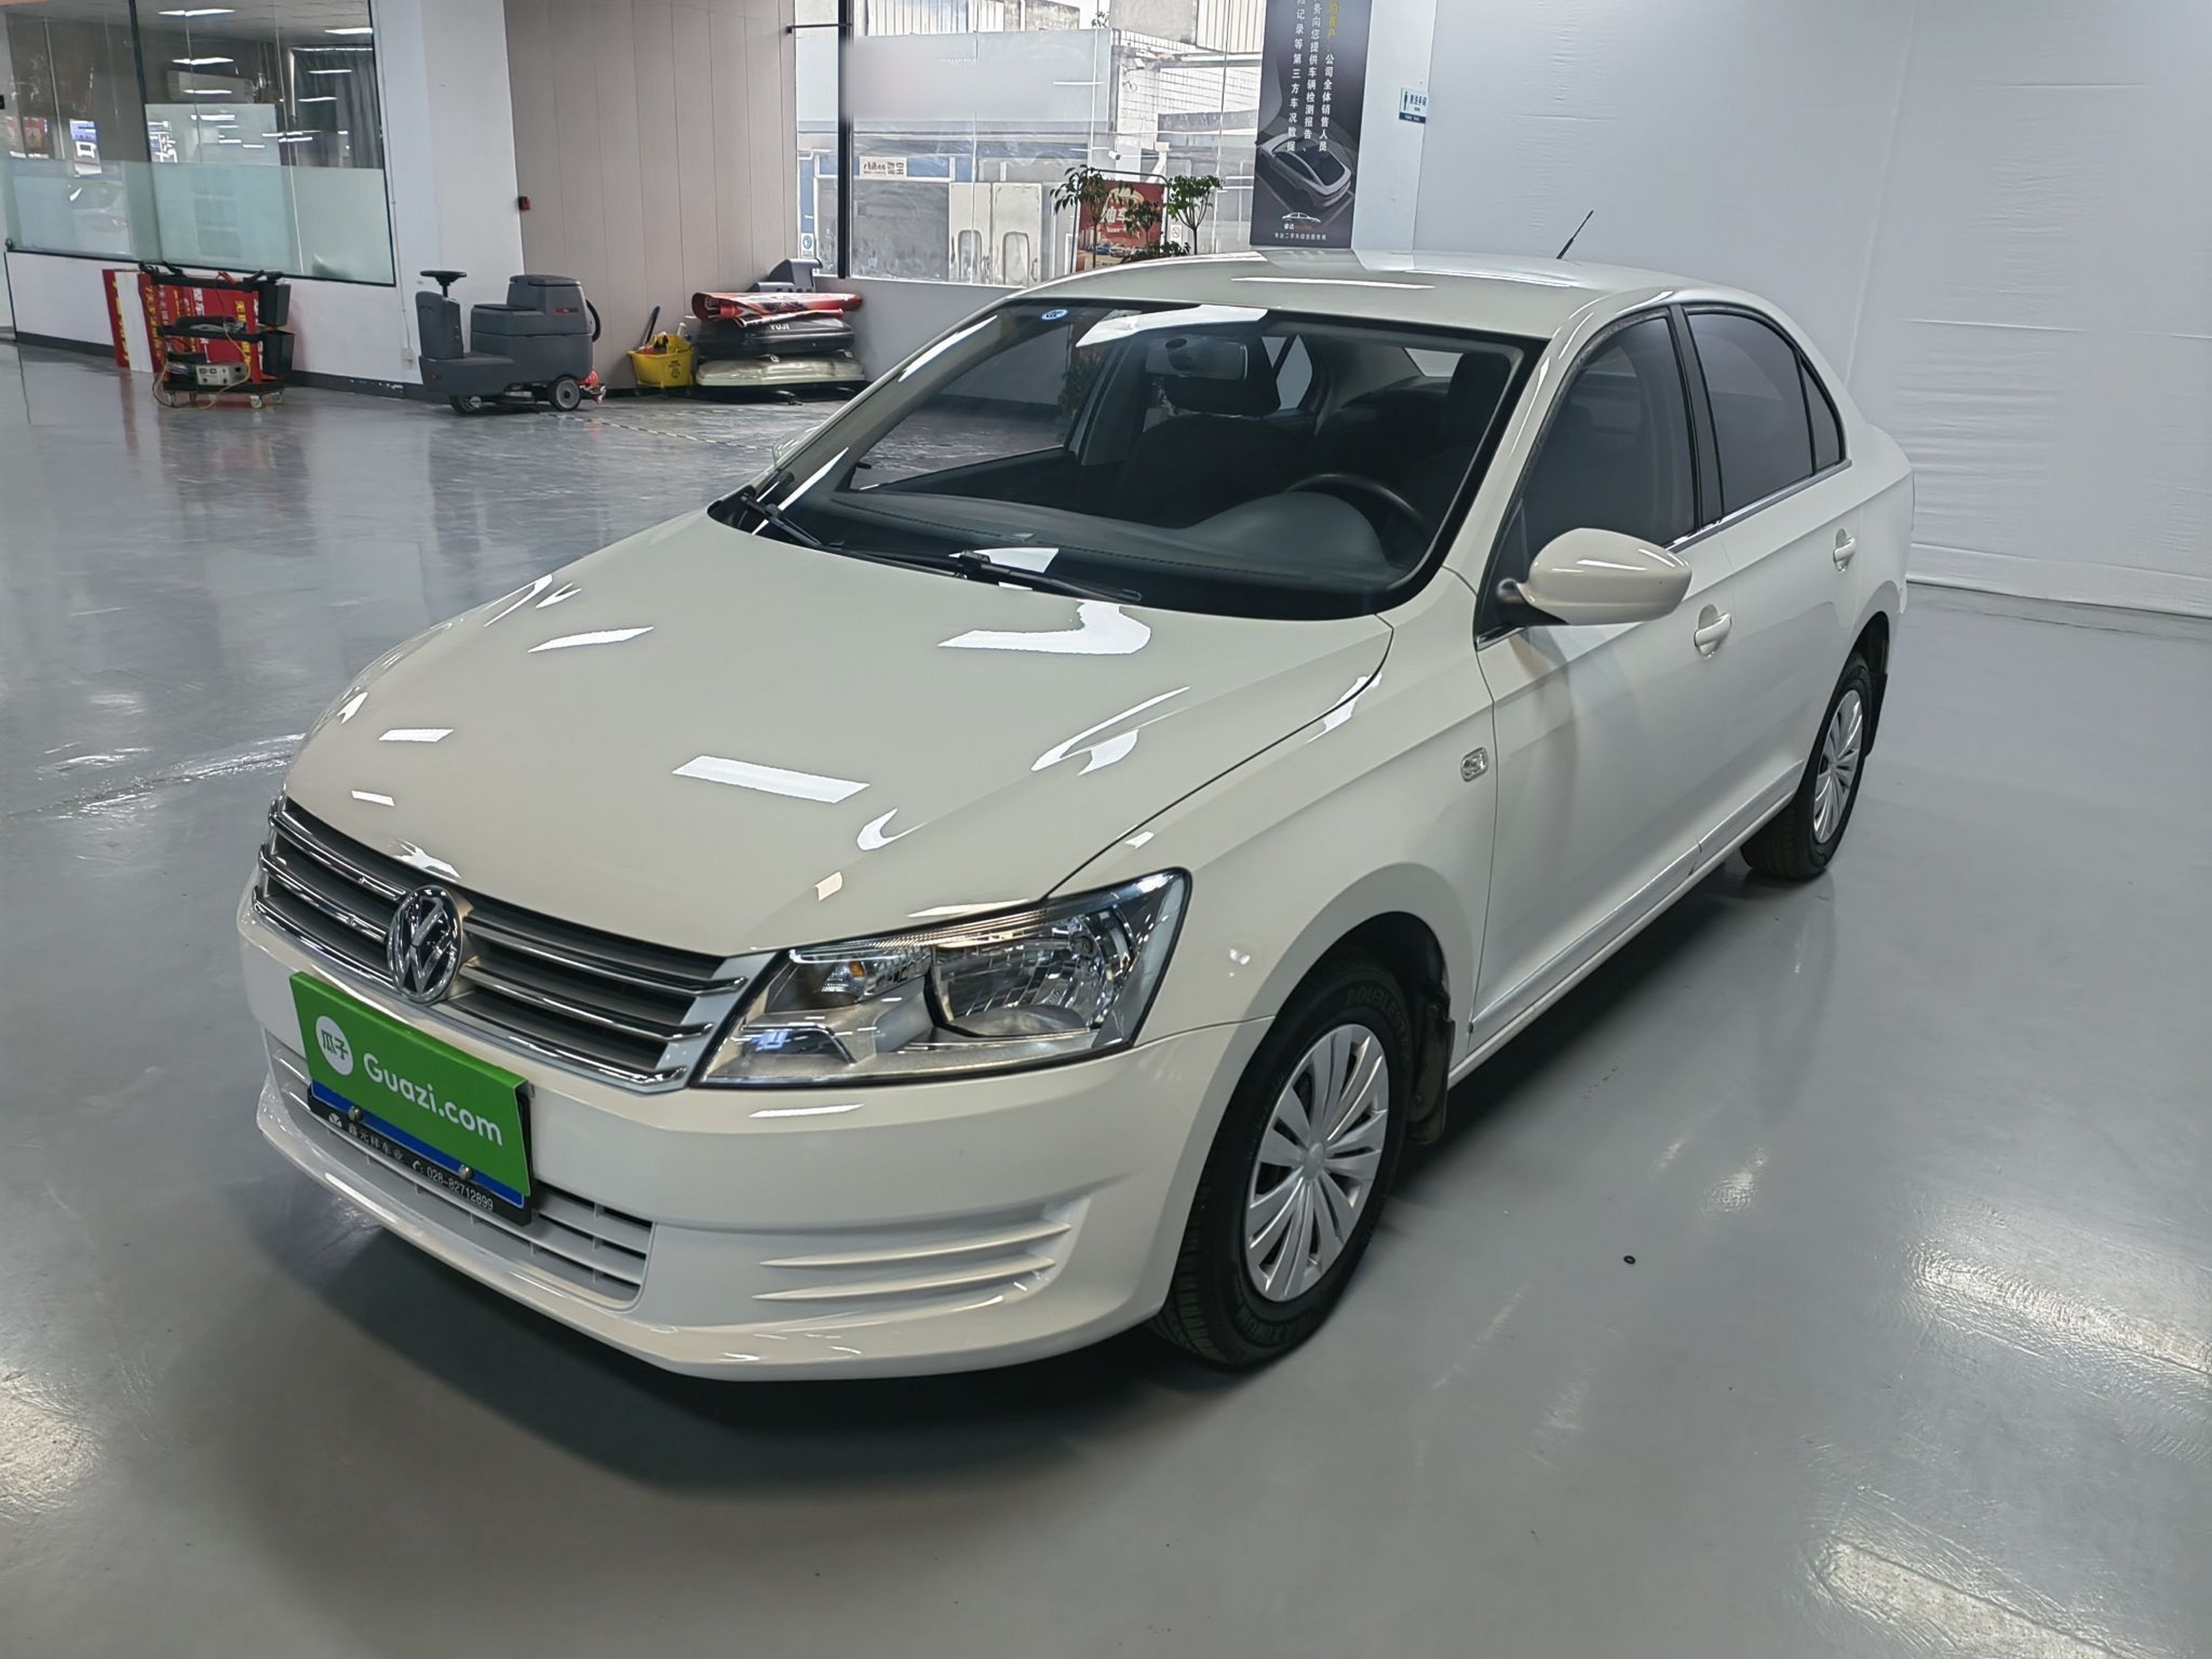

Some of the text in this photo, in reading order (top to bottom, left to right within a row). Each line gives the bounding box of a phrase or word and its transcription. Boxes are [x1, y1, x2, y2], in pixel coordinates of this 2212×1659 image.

[1302, 0, 1323, 152] 务向您提供车辆检测报告、
[321, 1029, 349, 1060] 瓜子
[363, 1053, 503, 1146] Guazi.com
